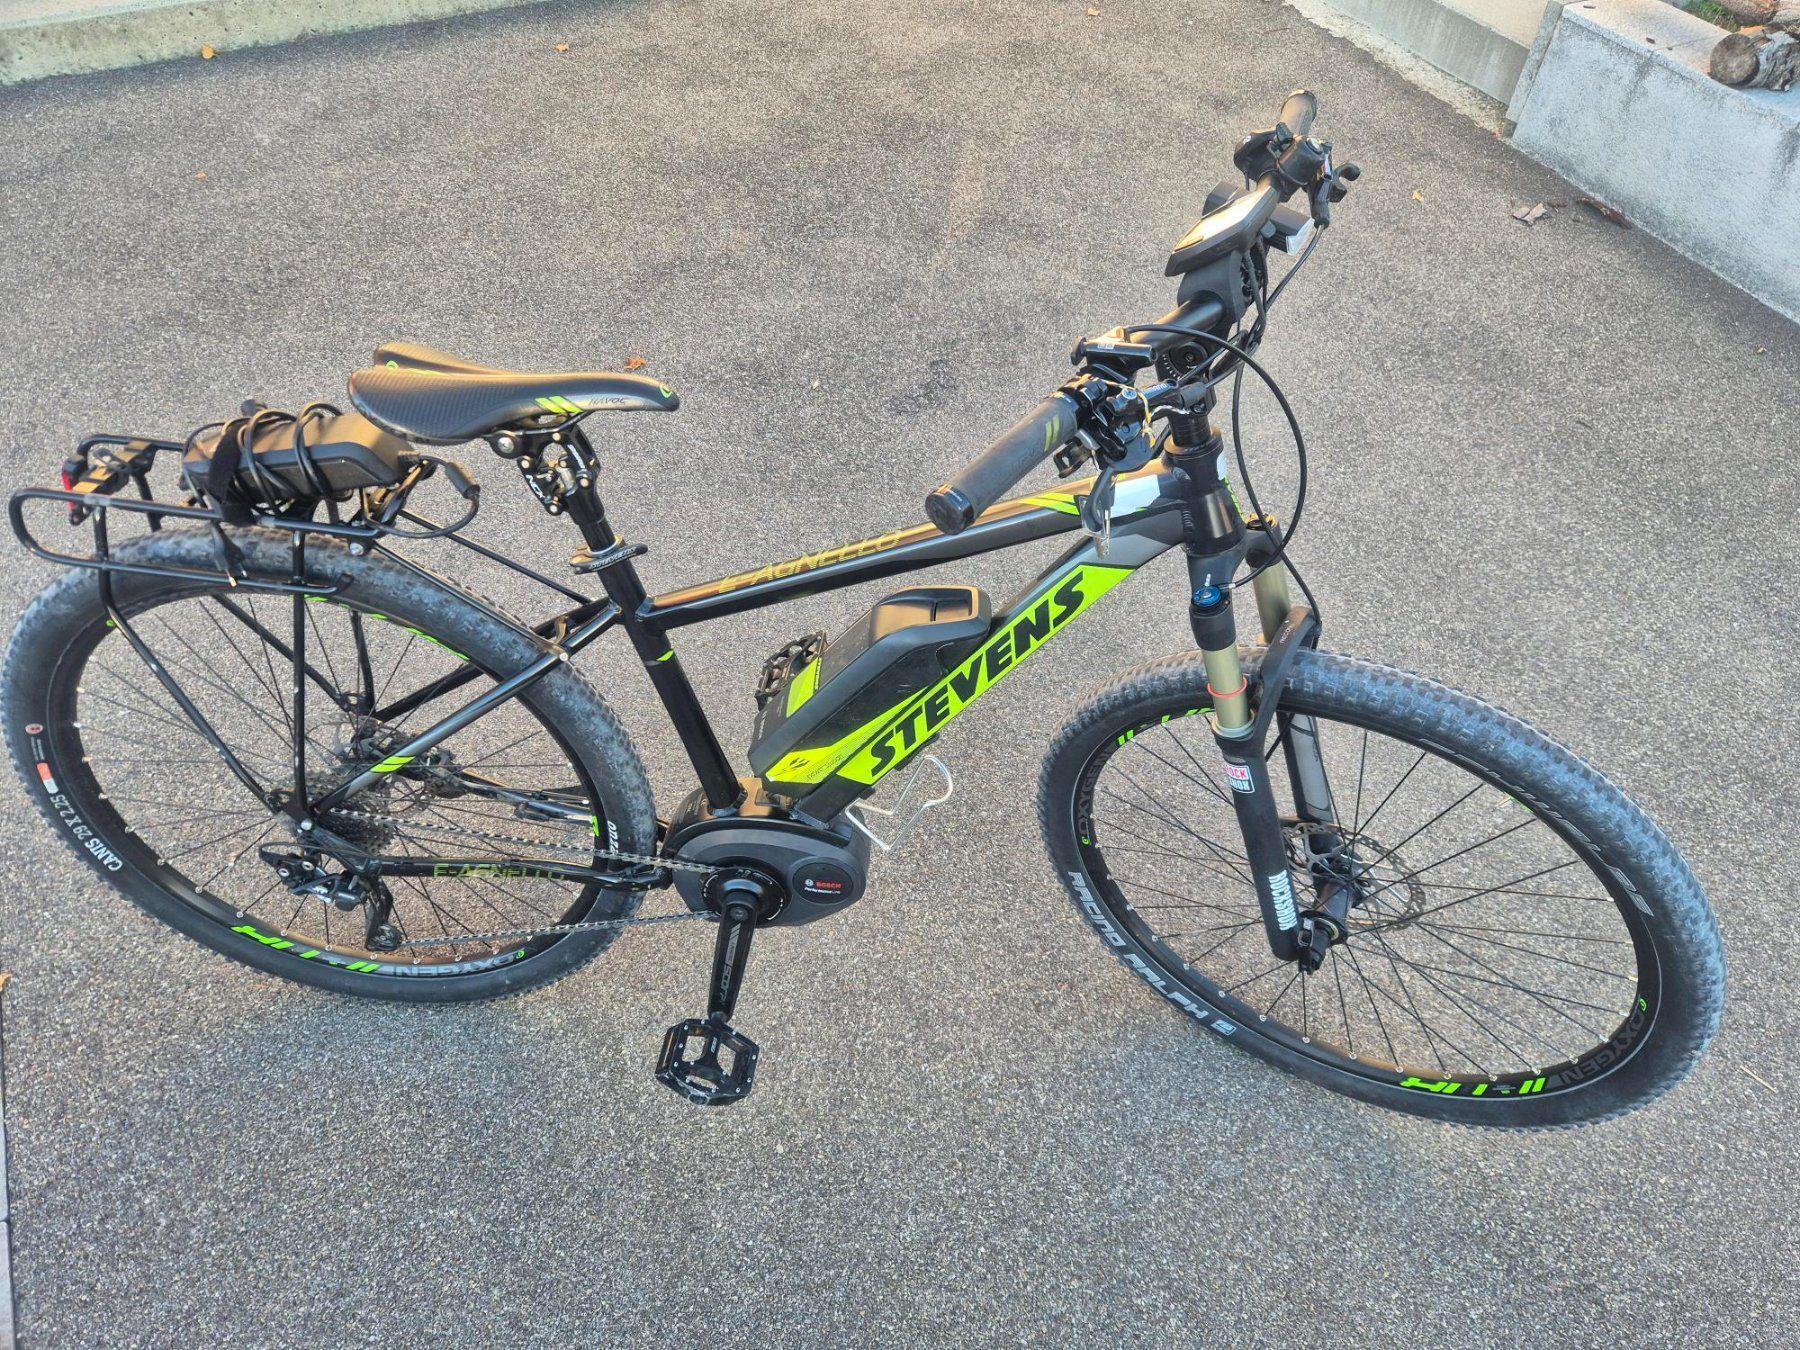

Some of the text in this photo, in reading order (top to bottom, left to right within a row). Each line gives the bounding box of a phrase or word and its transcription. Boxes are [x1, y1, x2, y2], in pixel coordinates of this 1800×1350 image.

[870, 570, 1085, 778] STEVENS
[51, 794, 75, 818] 2.25
[1077, 750, 1109, 836] OXYGEN
[73, 825, 93, 840] 29
[85, 838, 123, 871] CANIS
[815, 881, 842, 889] BOSCH
[1268, 869, 1298, 931] ROCKSHOX
[393, 950, 515, 977] OXYGEN
[1068, 871, 1209, 1018] RACING RALPH
[1561, 1012, 1645, 1086] OXYGEN
